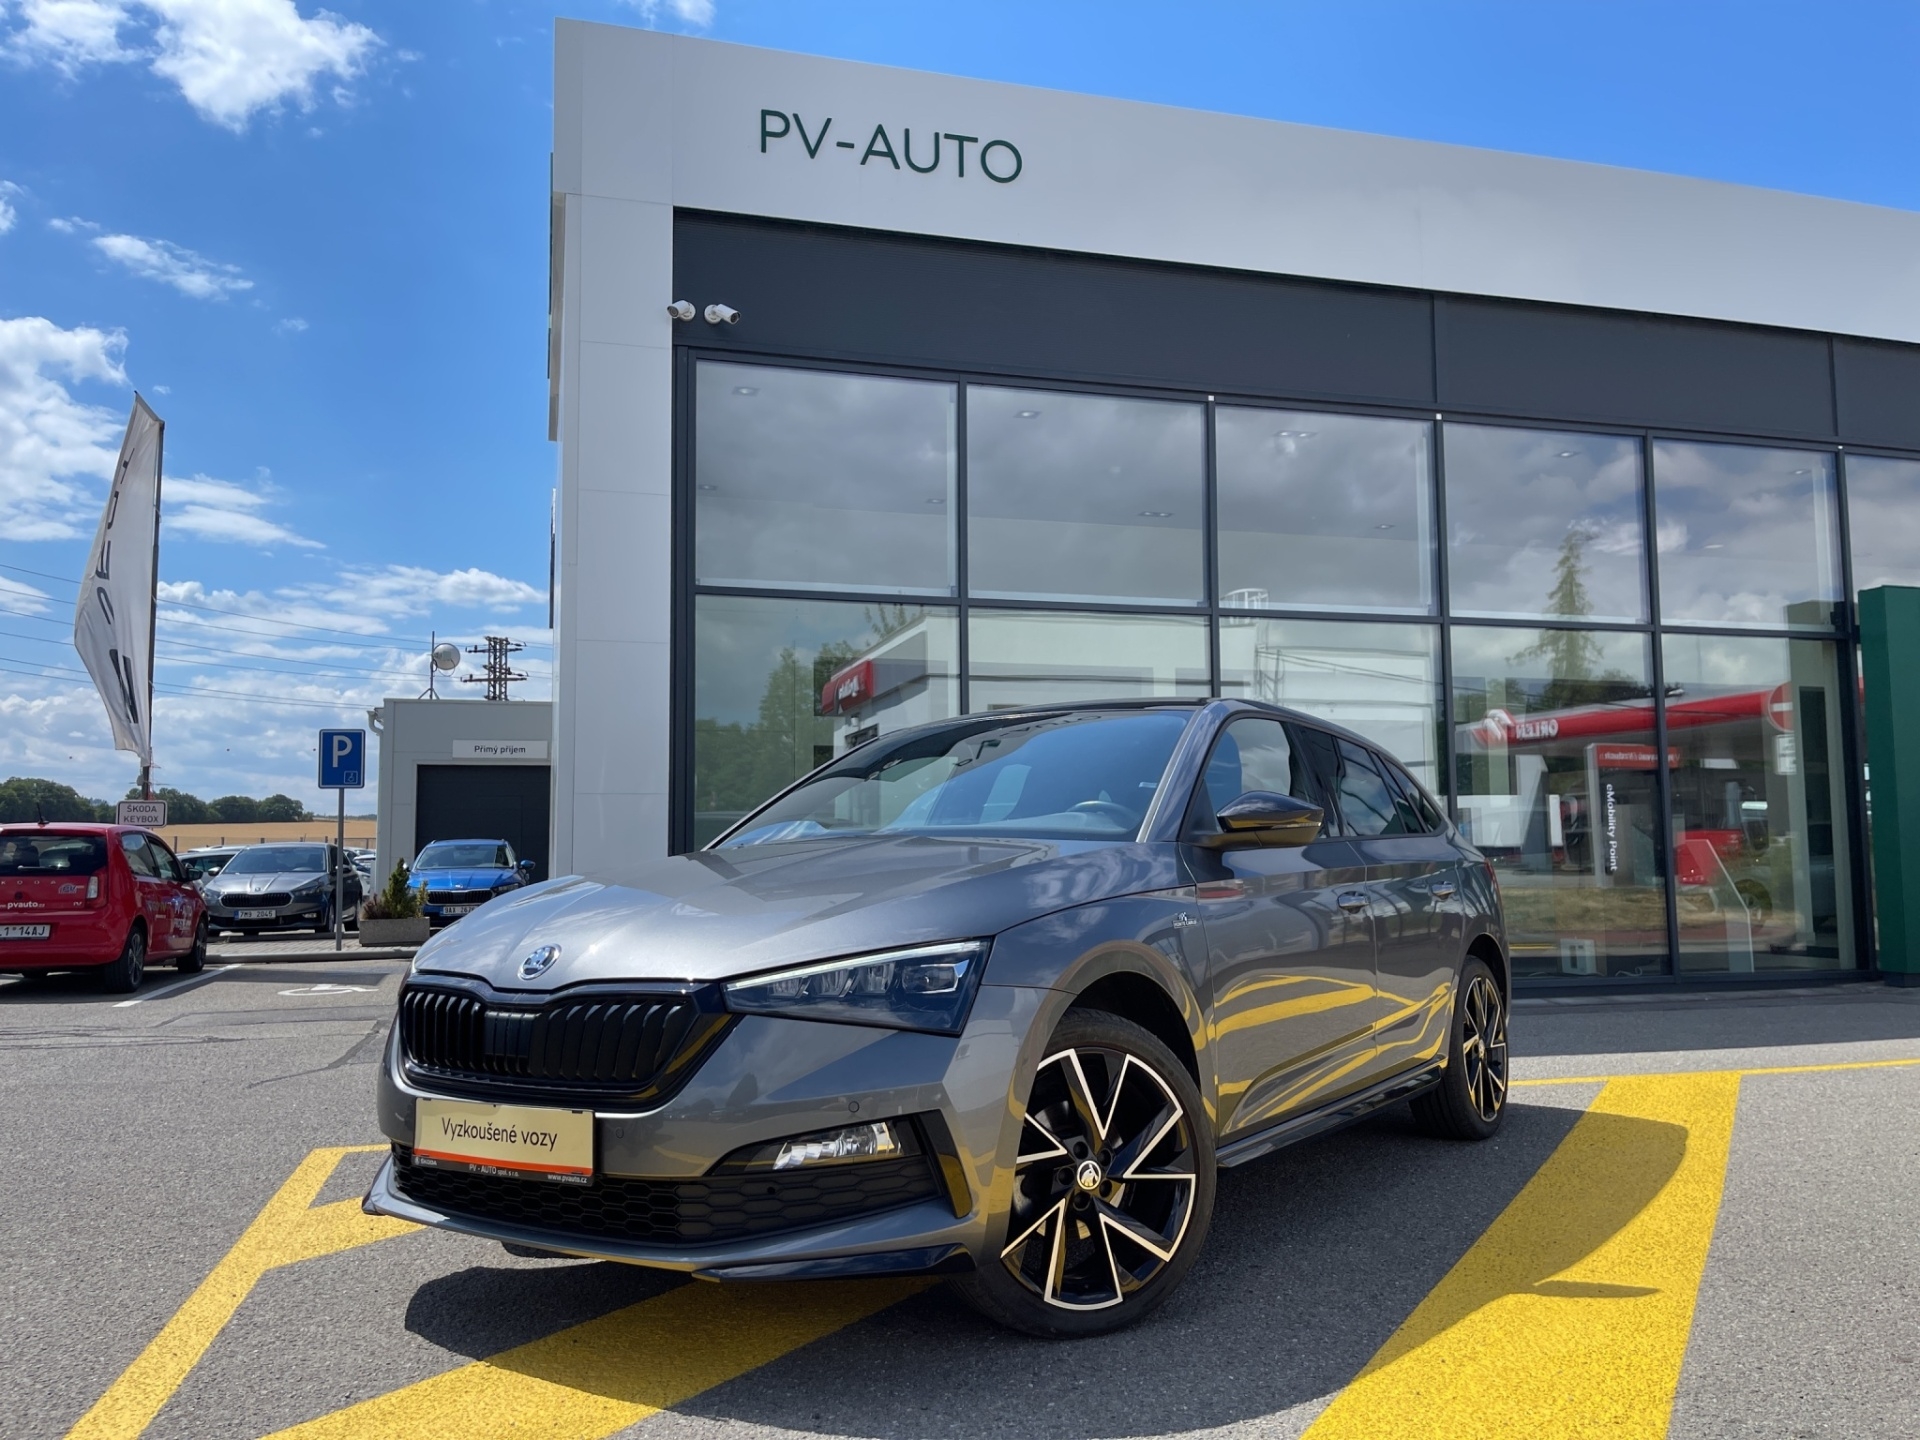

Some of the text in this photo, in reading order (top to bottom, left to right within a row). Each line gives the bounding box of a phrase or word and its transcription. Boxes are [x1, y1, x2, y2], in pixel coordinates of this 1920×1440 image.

[760, 109, 1022, 183] PV-AUTO
[332, 735, 353, 768] P
[123, 815, 159, 823] KEYBOX
[126, 804, 157, 813] ŠKODA
[1606, 784, 1618, 871] eMobility Point
[19, 926, 45, 936] 14AJ
[442, 1117, 558, 1152] Vyzkoušené vozy
[469, 1163, 477, 1172] PV
[481, 1165, 496, 1174] AUTO
